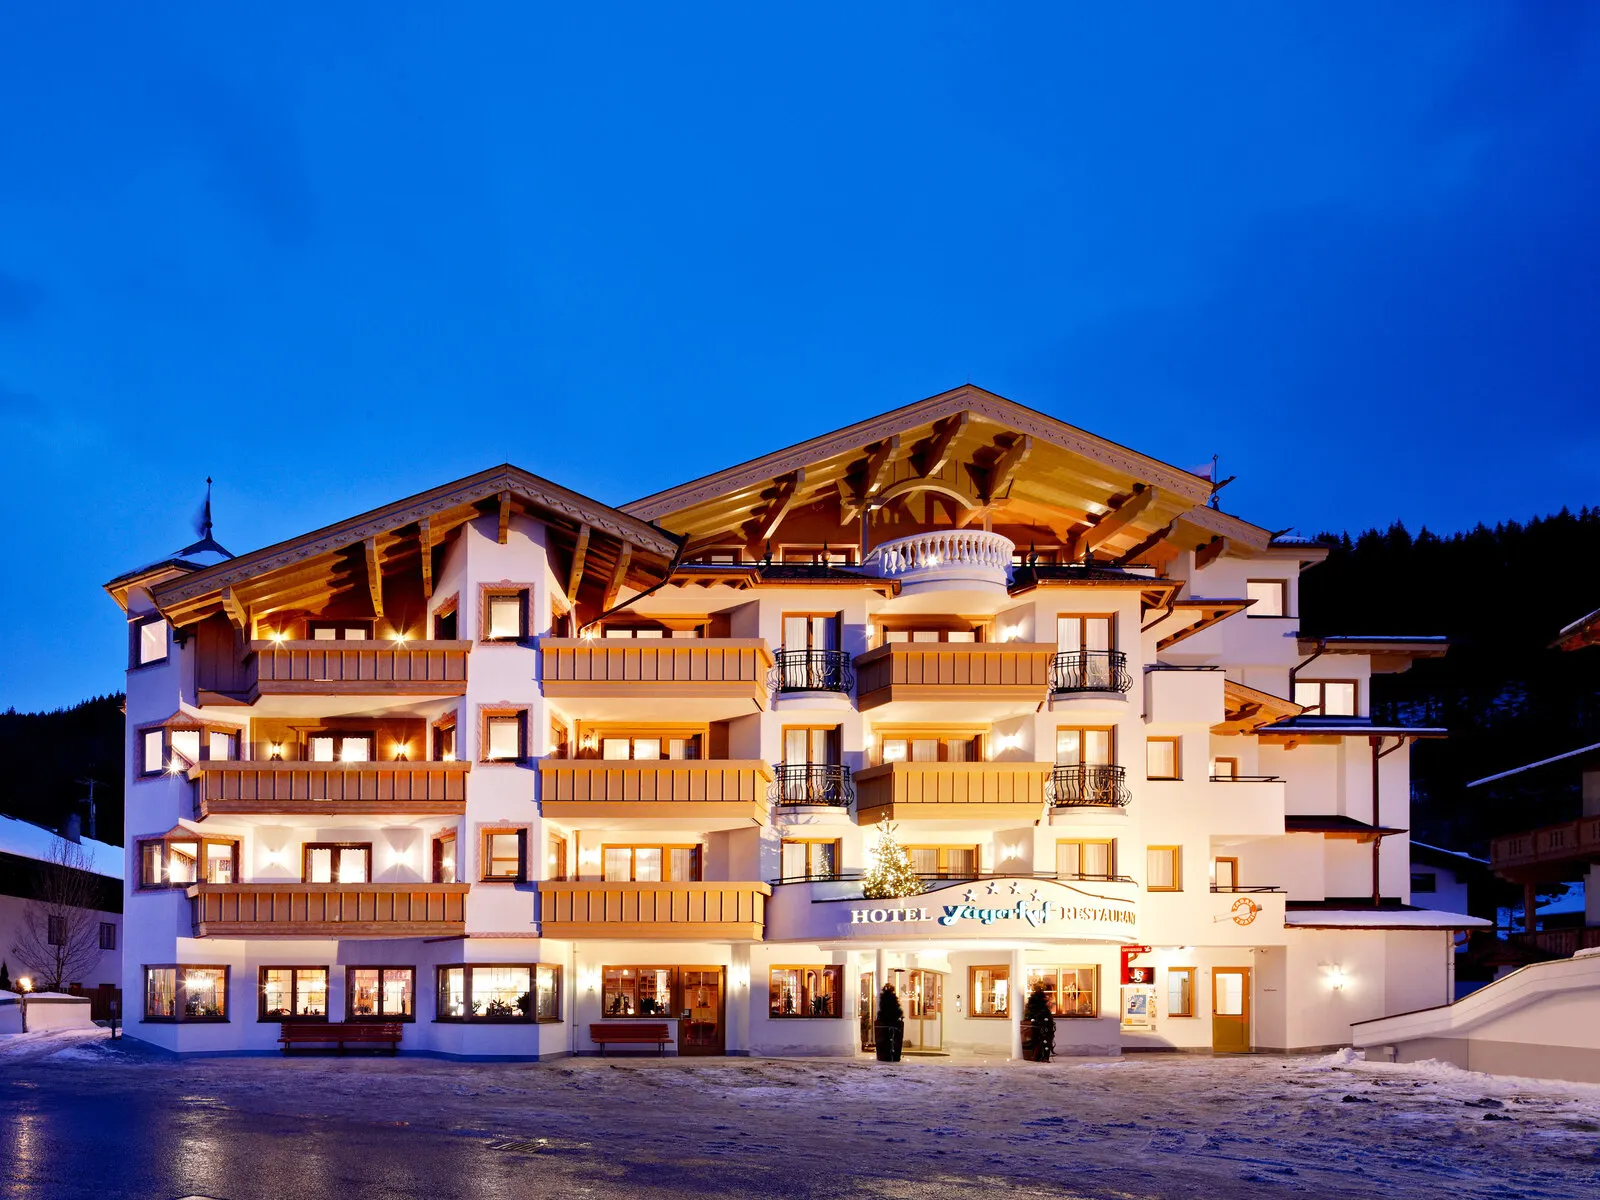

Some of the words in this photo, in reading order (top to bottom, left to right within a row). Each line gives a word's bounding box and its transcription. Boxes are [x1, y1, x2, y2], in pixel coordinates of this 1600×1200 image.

[1232, 898, 1255, 910] TABAK
[851, 907, 933, 924] HOTEL
[1060, 906, 1136, 926] RESTAURAN
[1234, 911, 1257, 925] TRAFIK
